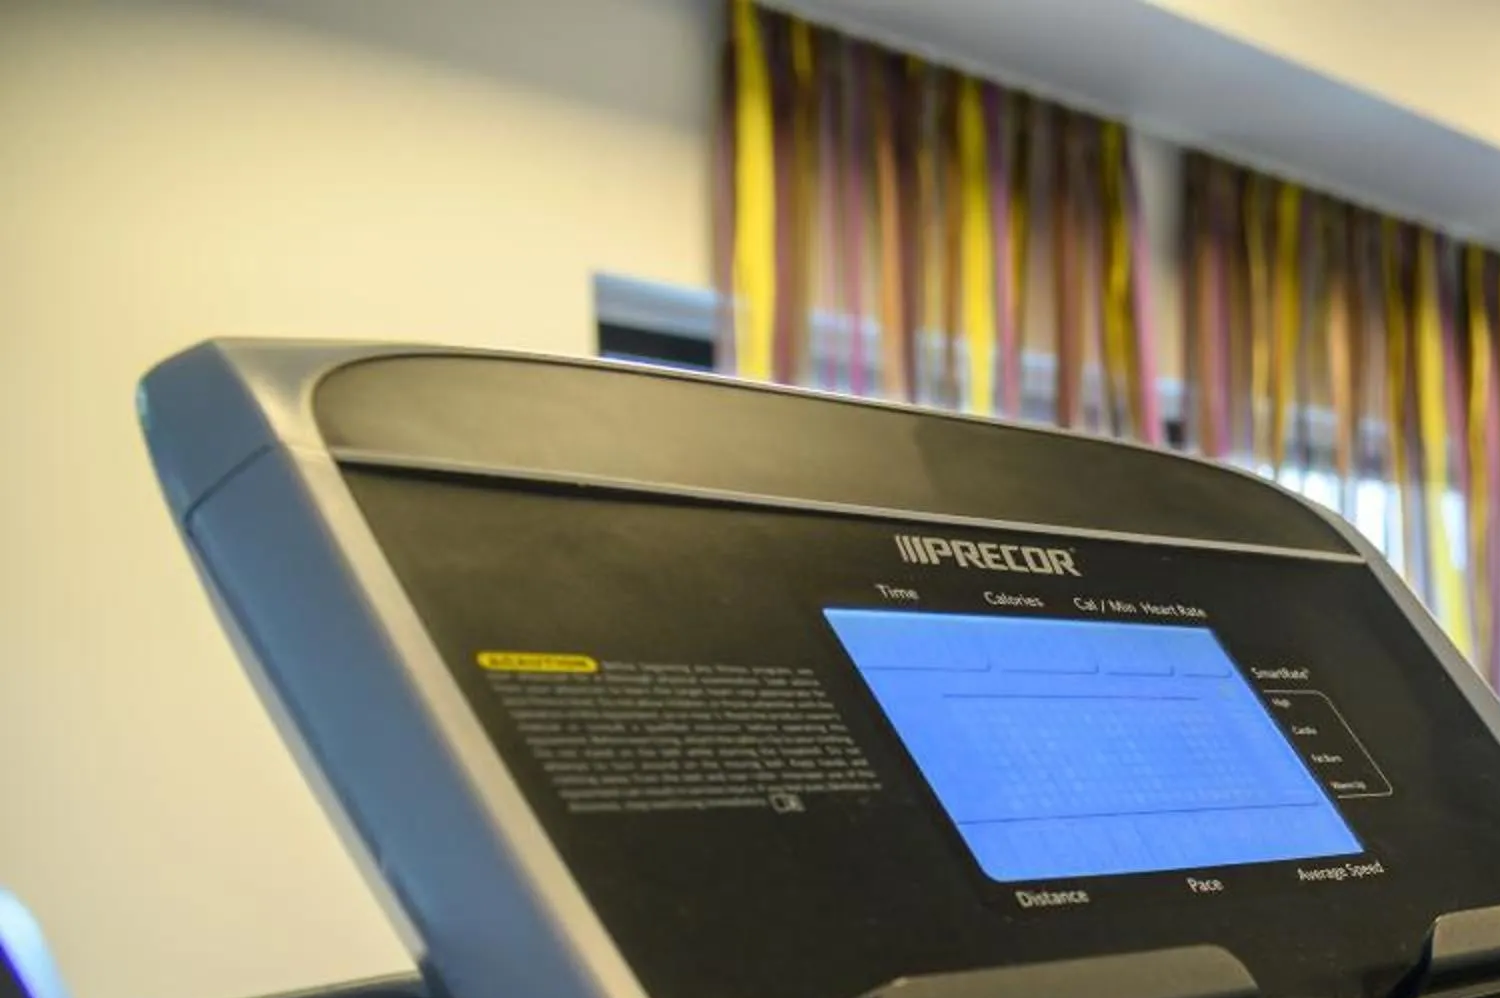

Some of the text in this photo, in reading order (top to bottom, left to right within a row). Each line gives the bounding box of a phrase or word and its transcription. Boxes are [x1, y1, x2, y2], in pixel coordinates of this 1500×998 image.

[916, 535, 1082, 577] PRECOR
[875, 583, 919, 600] Time
[983, 590, 1045, 608] Calories
[1073, 597, 1099, 612] Cal
[1108, 599, 1137, 614] Min
[1140, 601, 1207, 619] Heart Rate
[1297, 859, 1385, 883] Average Speed
[1186, 876, 1225, 894] Pace
[1015, 888, 1090, 909] Distance
